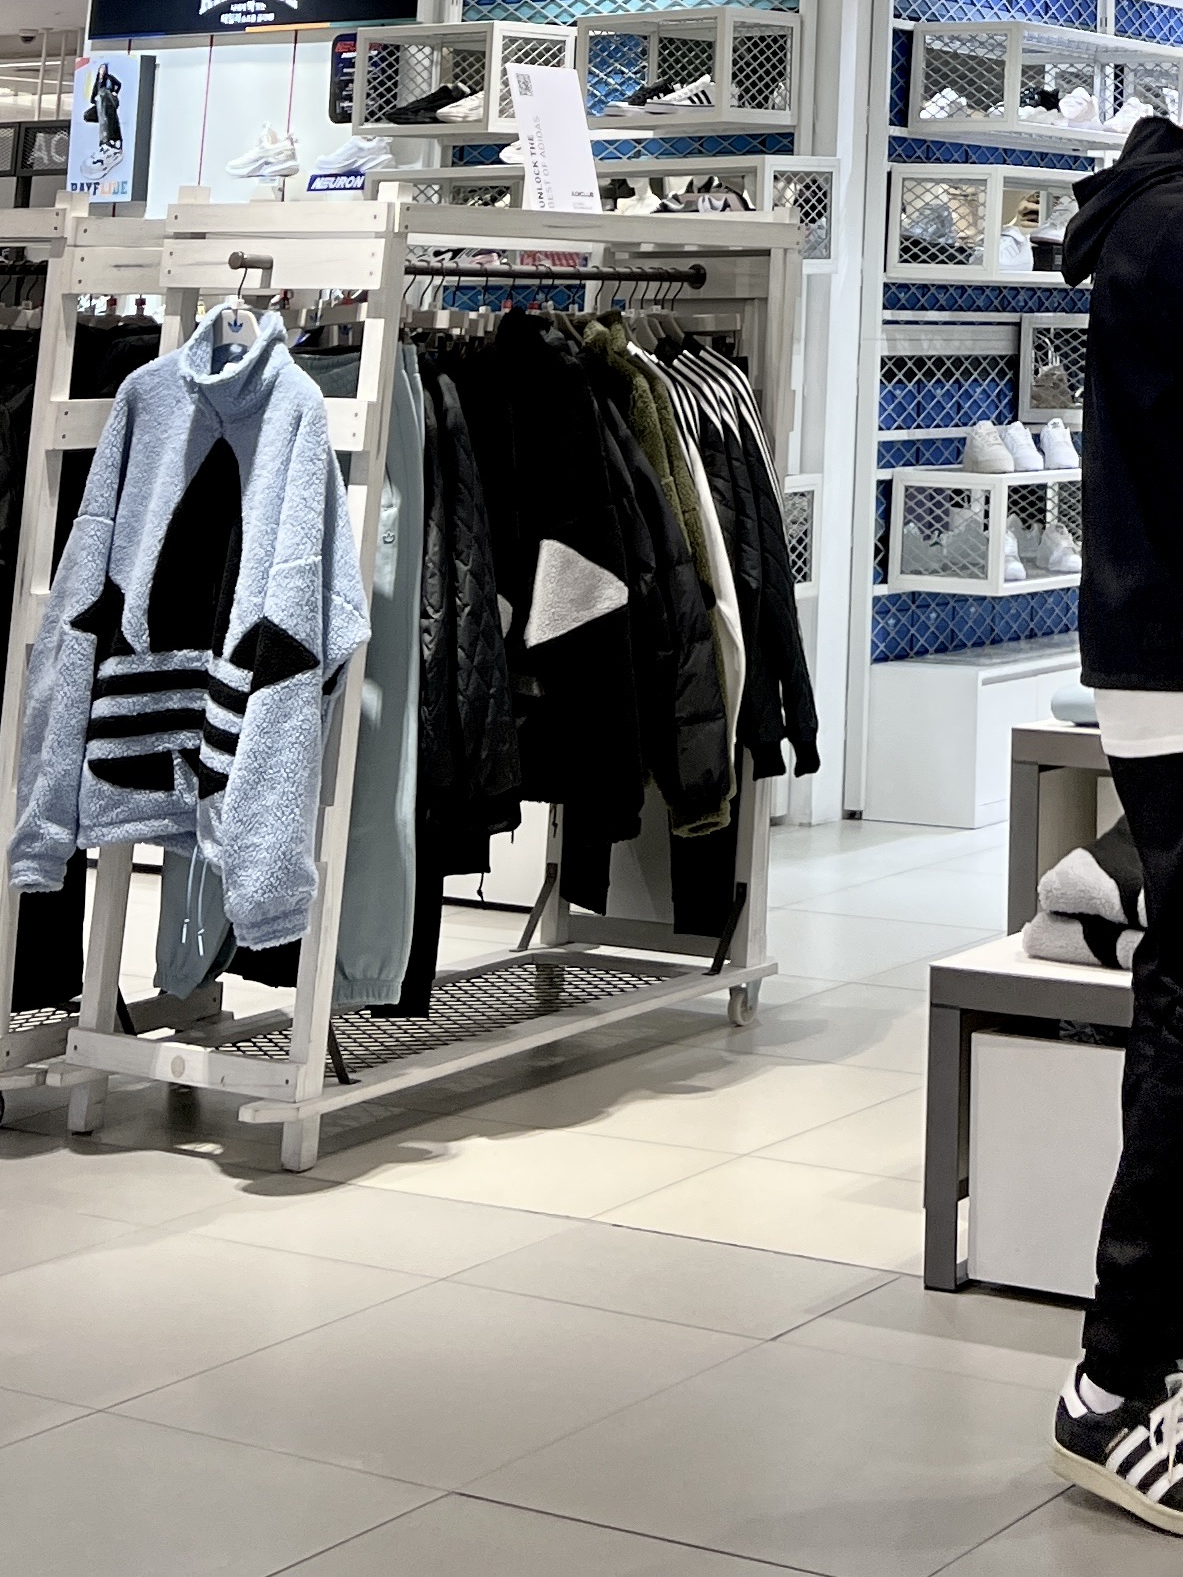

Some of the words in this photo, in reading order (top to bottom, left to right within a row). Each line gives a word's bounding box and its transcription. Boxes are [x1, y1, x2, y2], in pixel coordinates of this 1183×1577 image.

[527, 134, 538, 157] THE
[533, 115, 546, 158] ADIDAS
[541, 163, 550, 177] OF
[311, 175, 365, 190] NEURON
[532, 160, 546, 209] UNLOCK
